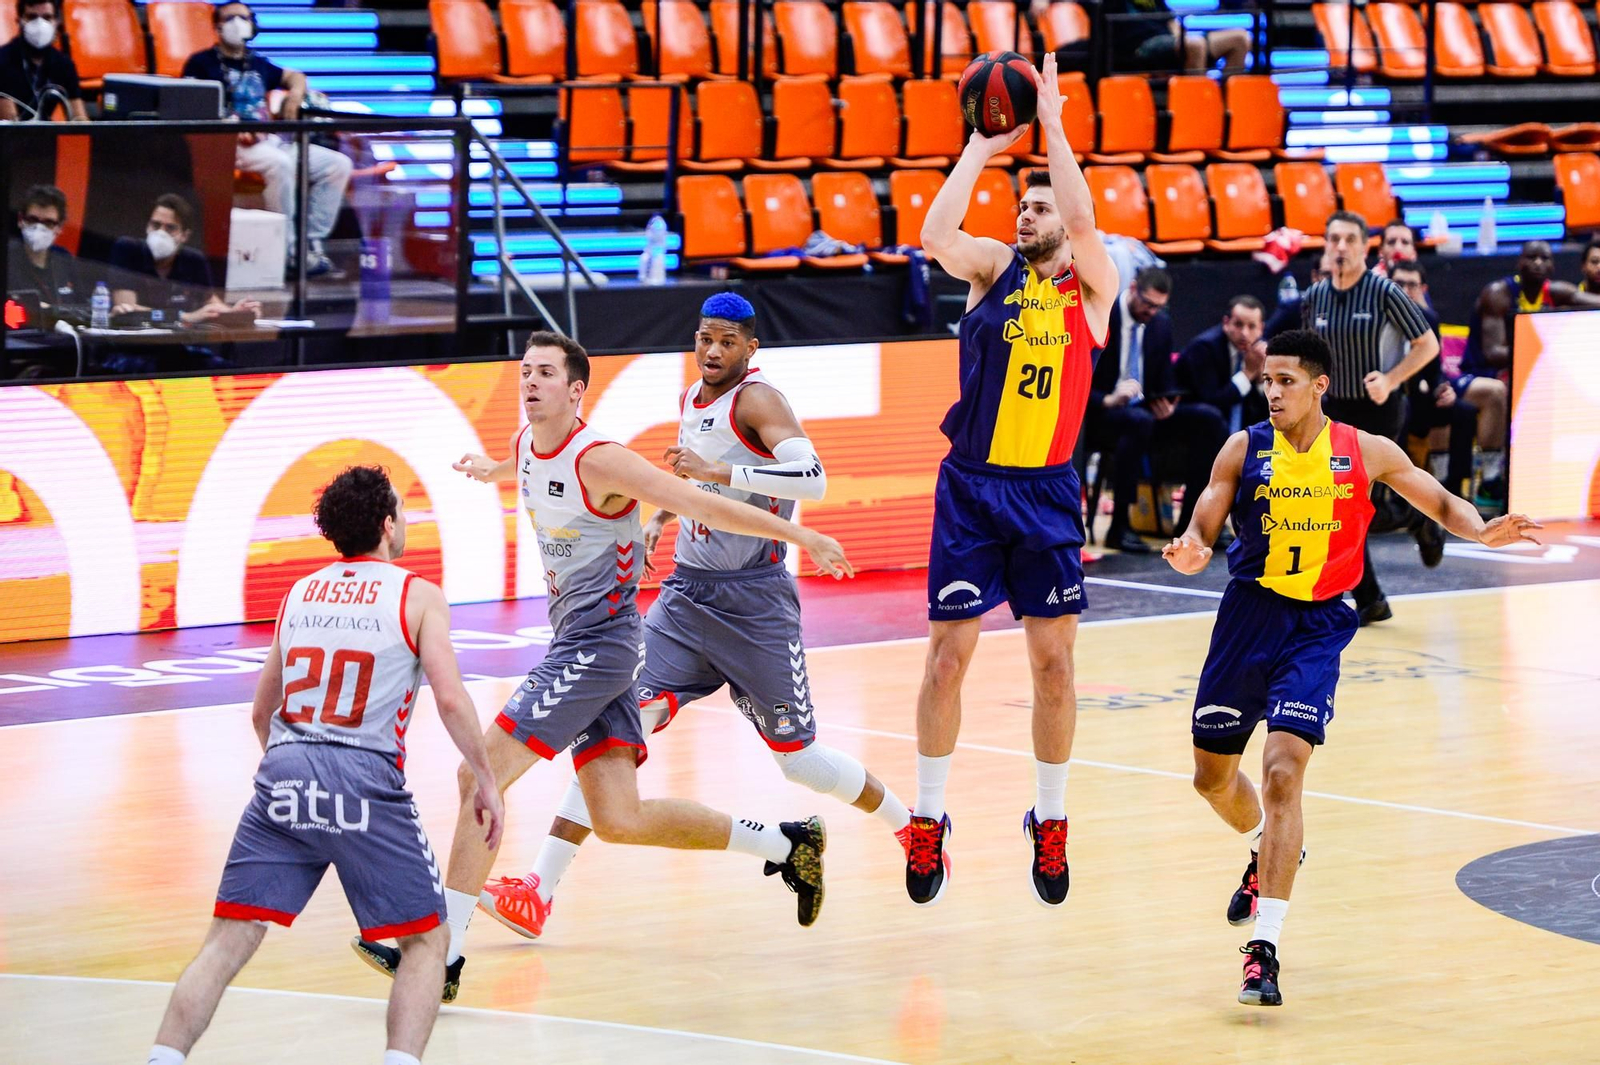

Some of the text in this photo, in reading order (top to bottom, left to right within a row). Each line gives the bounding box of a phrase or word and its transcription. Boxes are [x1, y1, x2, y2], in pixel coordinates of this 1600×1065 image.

[1017, 363, 1054, 400] 20
[1269, 485, 1353, 498] MORABANC
[690, 519, 712, 544] 14
[1279, 517, 1340, 531] Andorra
[1286, 546, 1303, 576] 1
[302, 579, 382, 604] BASSAS
[937, 599, 983, 611] Andorra la Vella
[299, 614, 382, 632] ARZUAGA
[279, 646, 375, 728] 20
[1284, 701, 1318, 713] andorra
[1281, 708, 1318, 723] telecom
[1226, 720, 1241, 728] Vella
[273, 779, 304, 790] GRUPO
[267, 780, 370, 832] atu
[290, 822, 342, 835] FORMACIÓN
